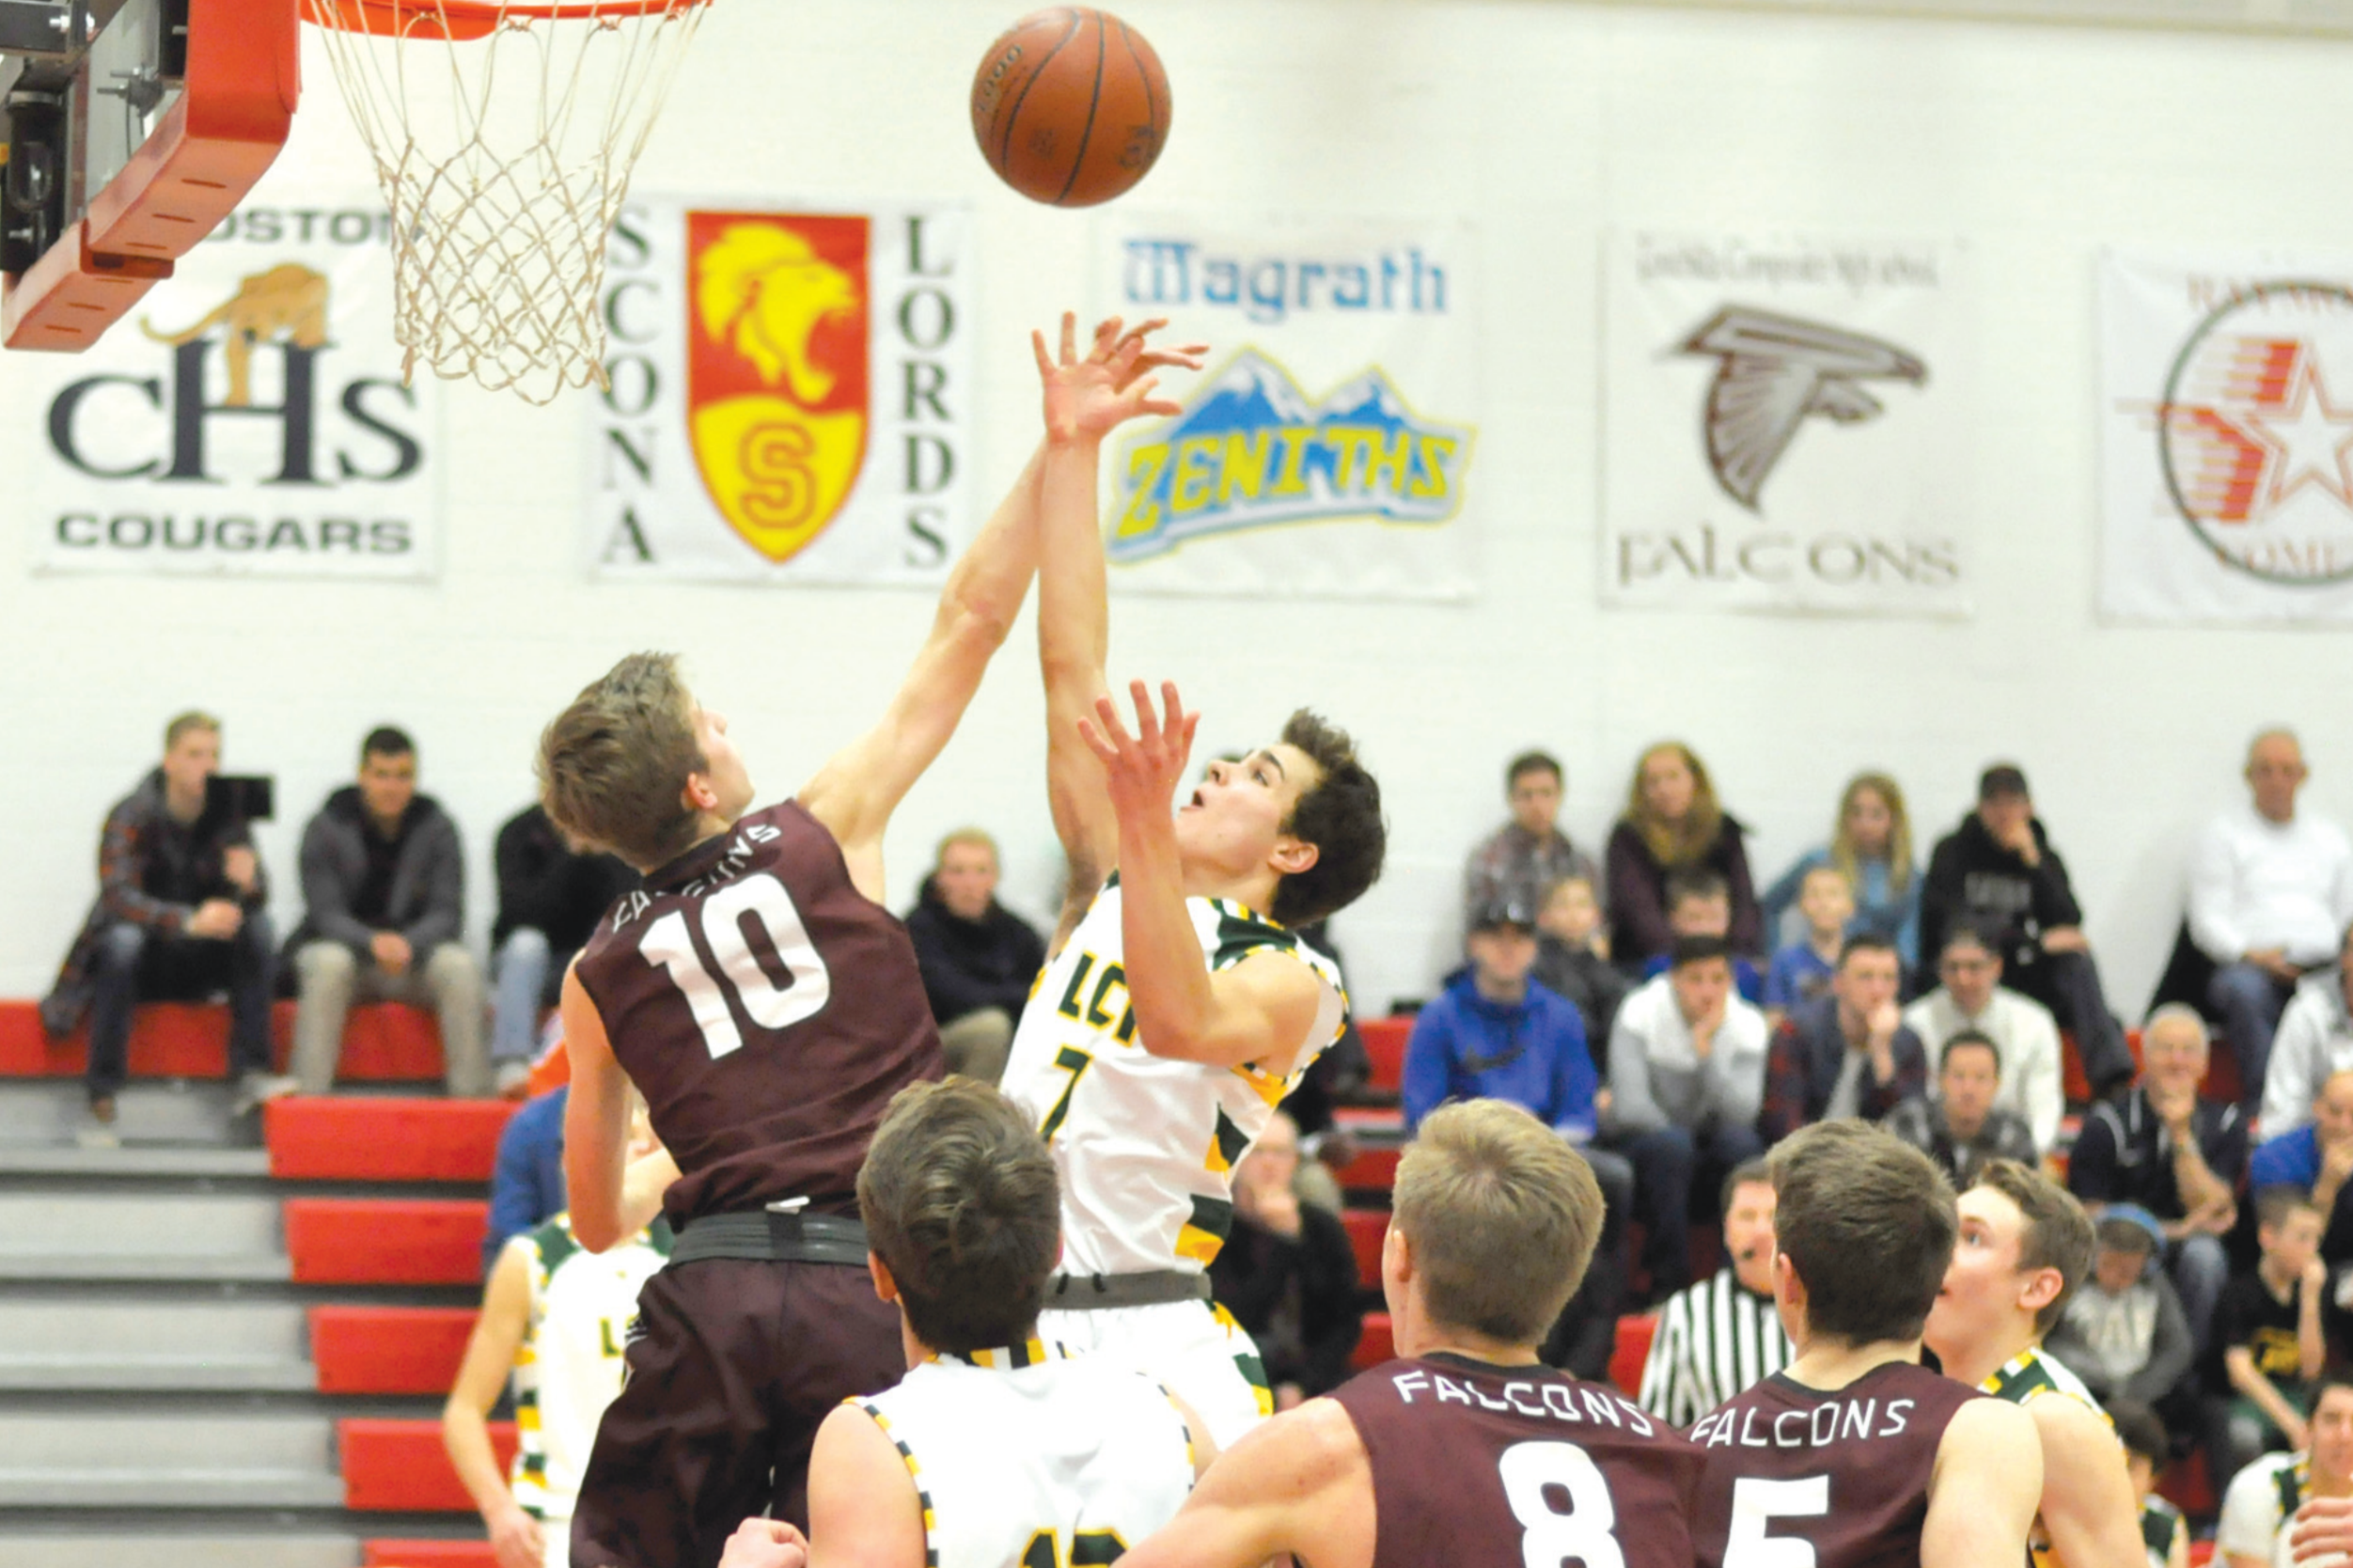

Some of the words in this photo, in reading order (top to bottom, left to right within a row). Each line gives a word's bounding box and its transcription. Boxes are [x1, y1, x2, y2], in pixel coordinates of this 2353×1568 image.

[1122, 238, 1449, 324] Magrath
[45, 338, 425, 489] CHS
[602, 206, 660, 565] SCONA
[896, 214, 956, 569] LORDS
[55, 511, 414, 555] COUGARS
[1115, 426, 1458, 541] ZENITHS
[1617, 522, 1960, 588] FALCONS
[637, 871, 831, 1061] 10
[1037, 1043, 1095, 1152] 7
[1392, 1369, 1655, 1437] FALCONS
[1689, 1397, 1916, 1449] FALCONS
[1498, 1439, 1628, 1568] 8
[1722, 1473, 1829, 1568] 5
